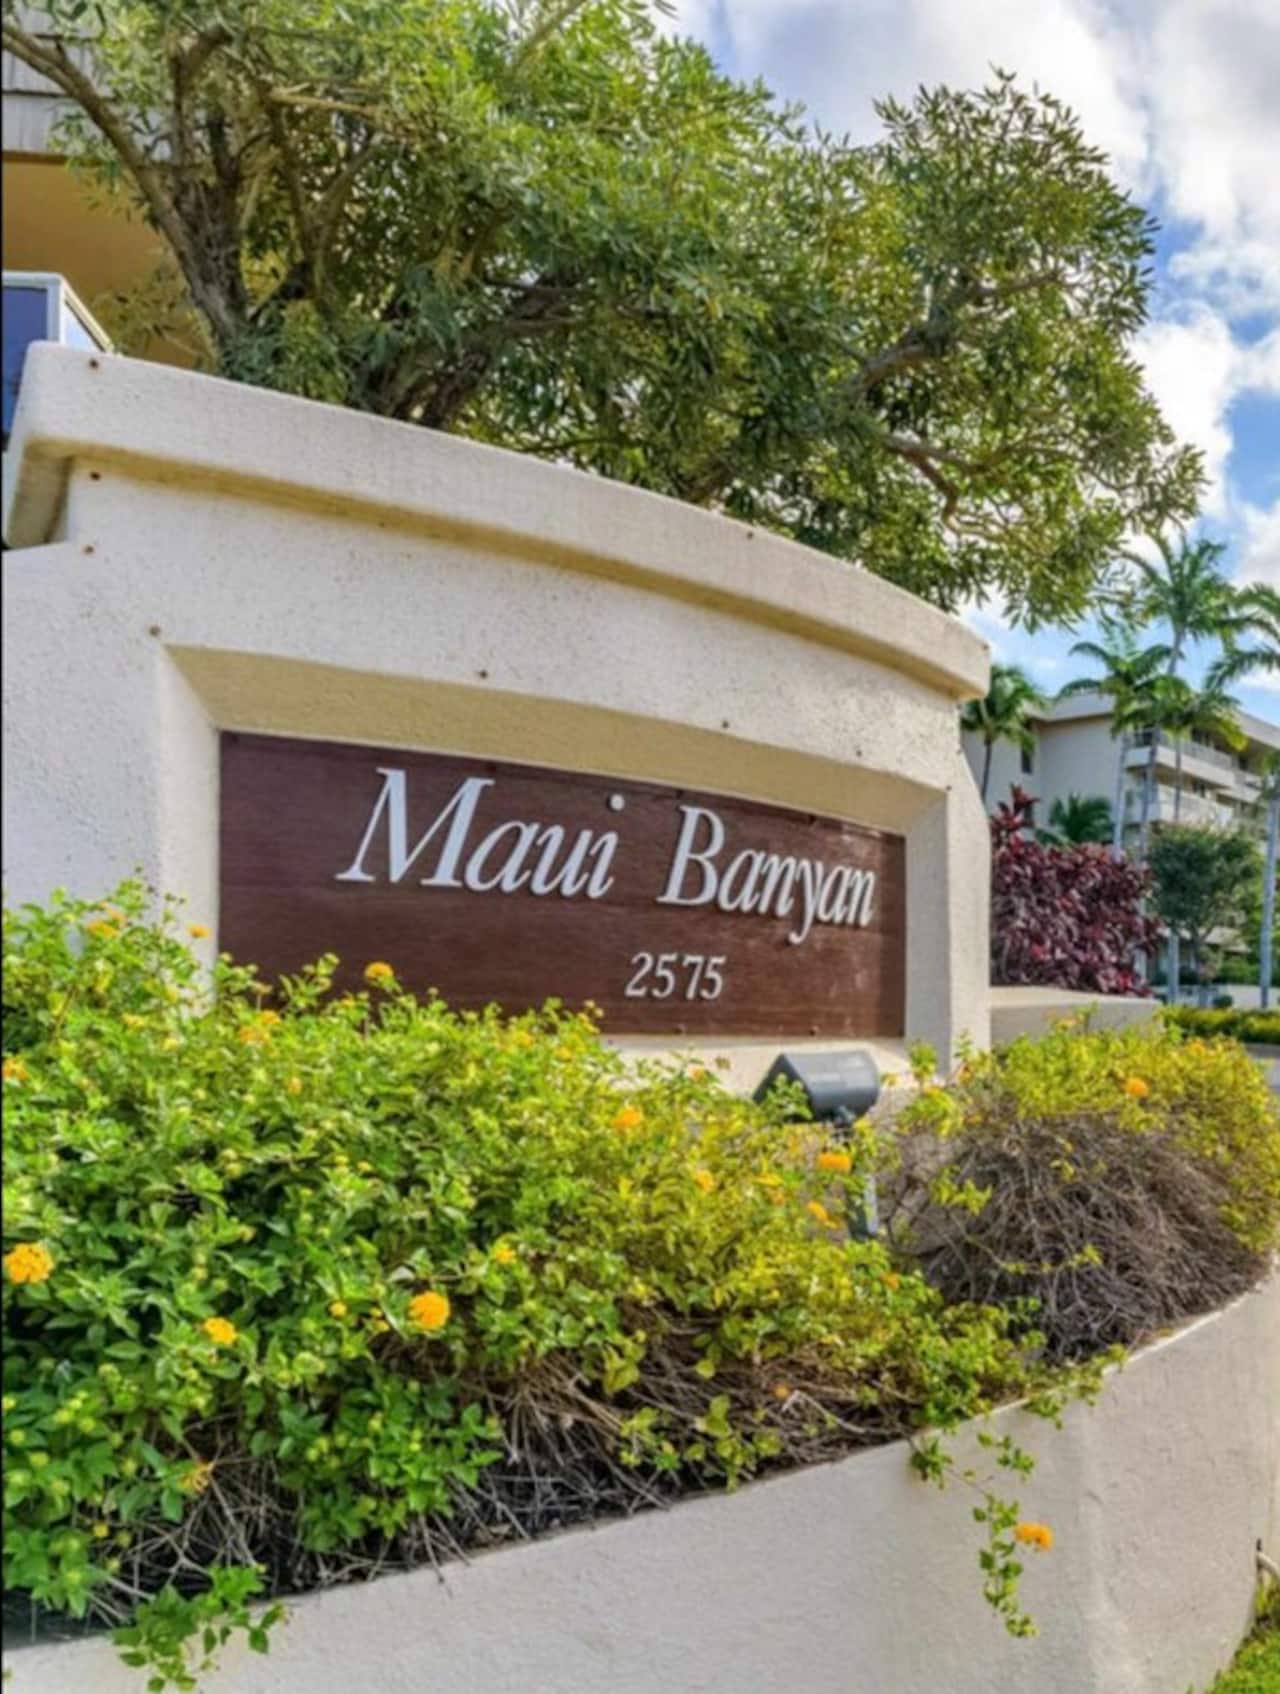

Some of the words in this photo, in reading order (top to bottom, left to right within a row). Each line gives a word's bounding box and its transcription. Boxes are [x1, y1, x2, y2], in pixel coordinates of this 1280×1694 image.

[336, 767, 625, 898] Maui
[657, 804, 876, 944] Banyan
[624, 952, 727, 999] 2575
